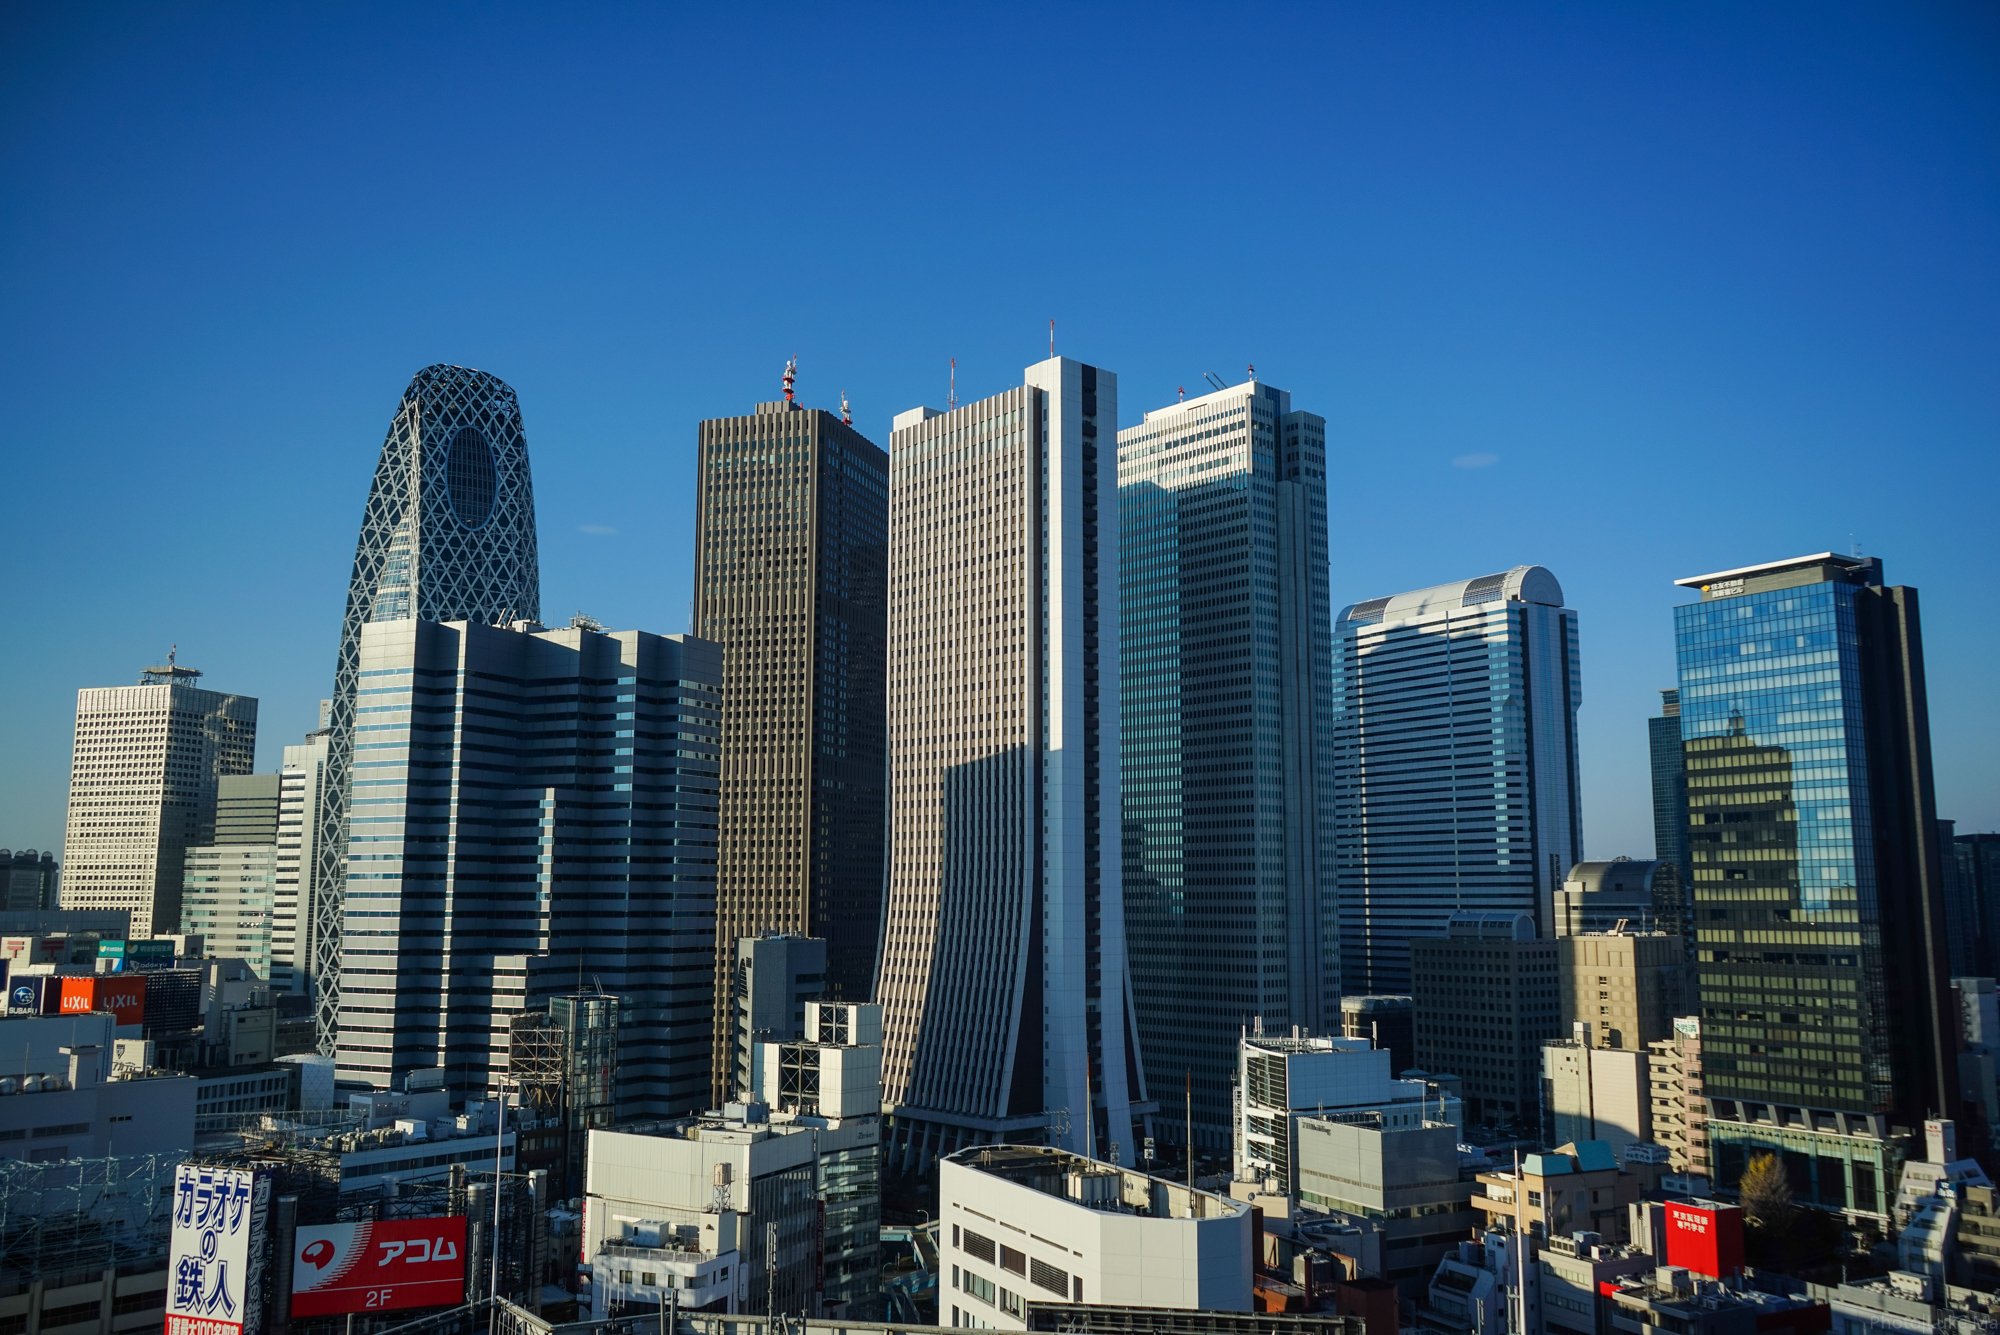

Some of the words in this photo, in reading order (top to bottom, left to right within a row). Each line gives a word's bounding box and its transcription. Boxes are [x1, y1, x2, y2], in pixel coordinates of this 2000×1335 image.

[63, 996, 89, 1010] LIXIL
[103, 994, 138, 1008] LIXIL
[8, 1007, 38, 1015] SUBARU
[175, 1167, 250, 1236] カラオケ
[1677, 1220, 1706, 1234] 専門学校
[200, 1226, 218, 1264] の
[378, 1237, 458, 1267] アコム
[174, 1254, 237, 1319] 鉄人
[365, 1289, 393, 1308] 2F
